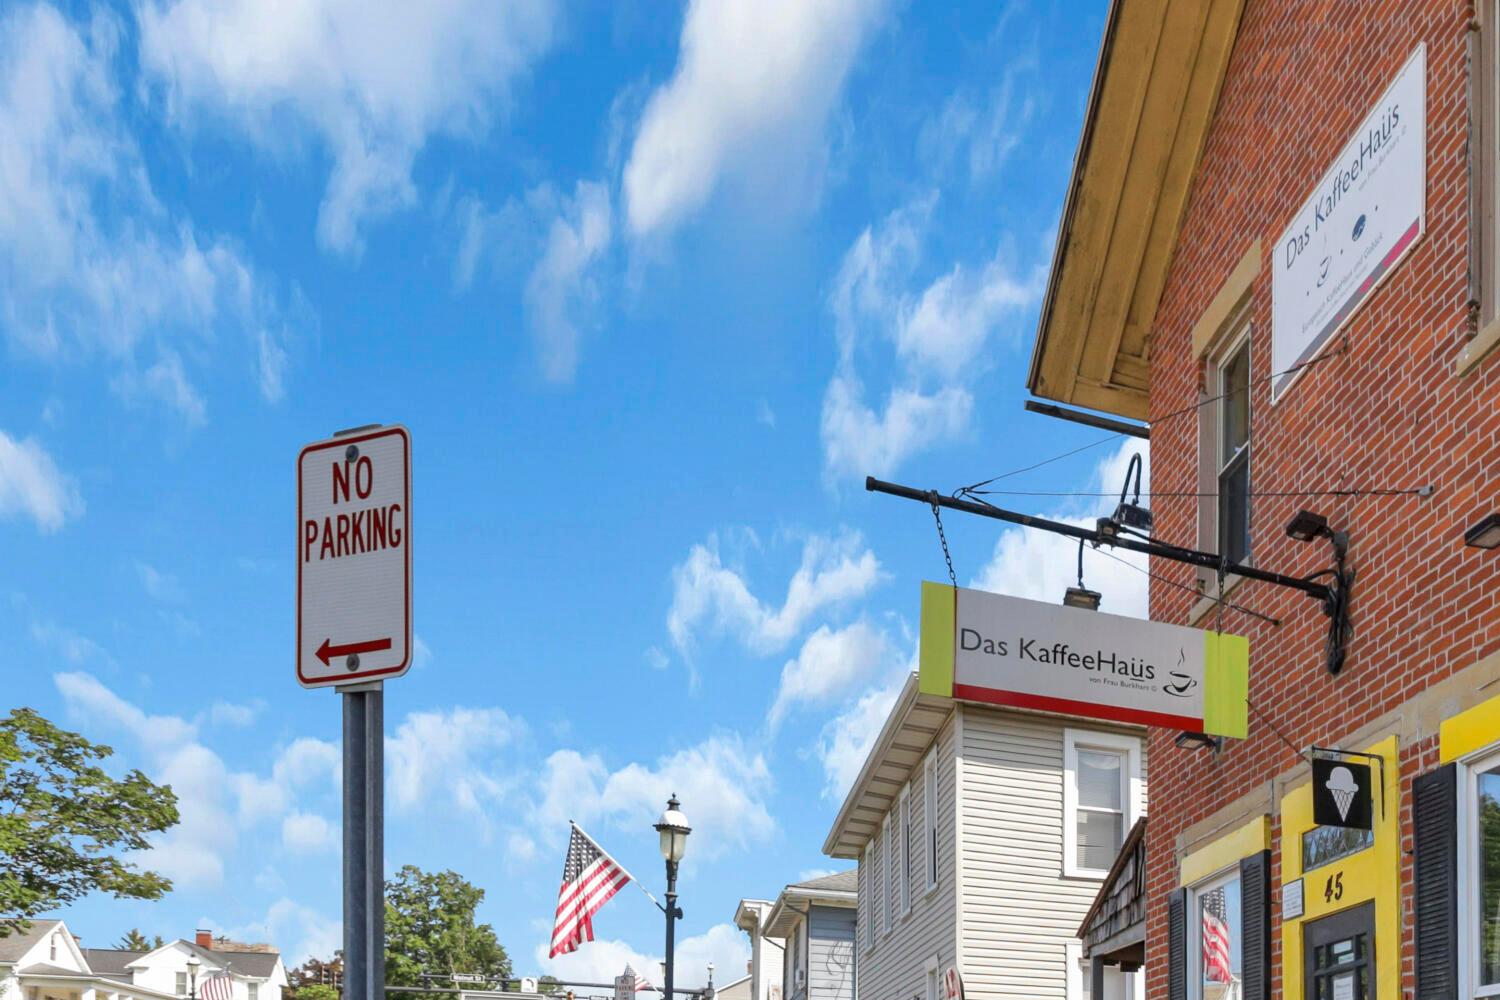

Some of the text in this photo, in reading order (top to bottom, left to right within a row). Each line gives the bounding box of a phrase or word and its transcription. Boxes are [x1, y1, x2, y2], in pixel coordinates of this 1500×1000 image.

[1286, 223, 1310, 270] Das
[1314, 104, 1400, 232] KaffeeHaüs
[332, 455, 373, 504] NO
[305, 503, 402, 563] PARKING
[960, 627, 1155, 682] Das KaffeeHaüs
[1324, 871, 1343, 903] 45
